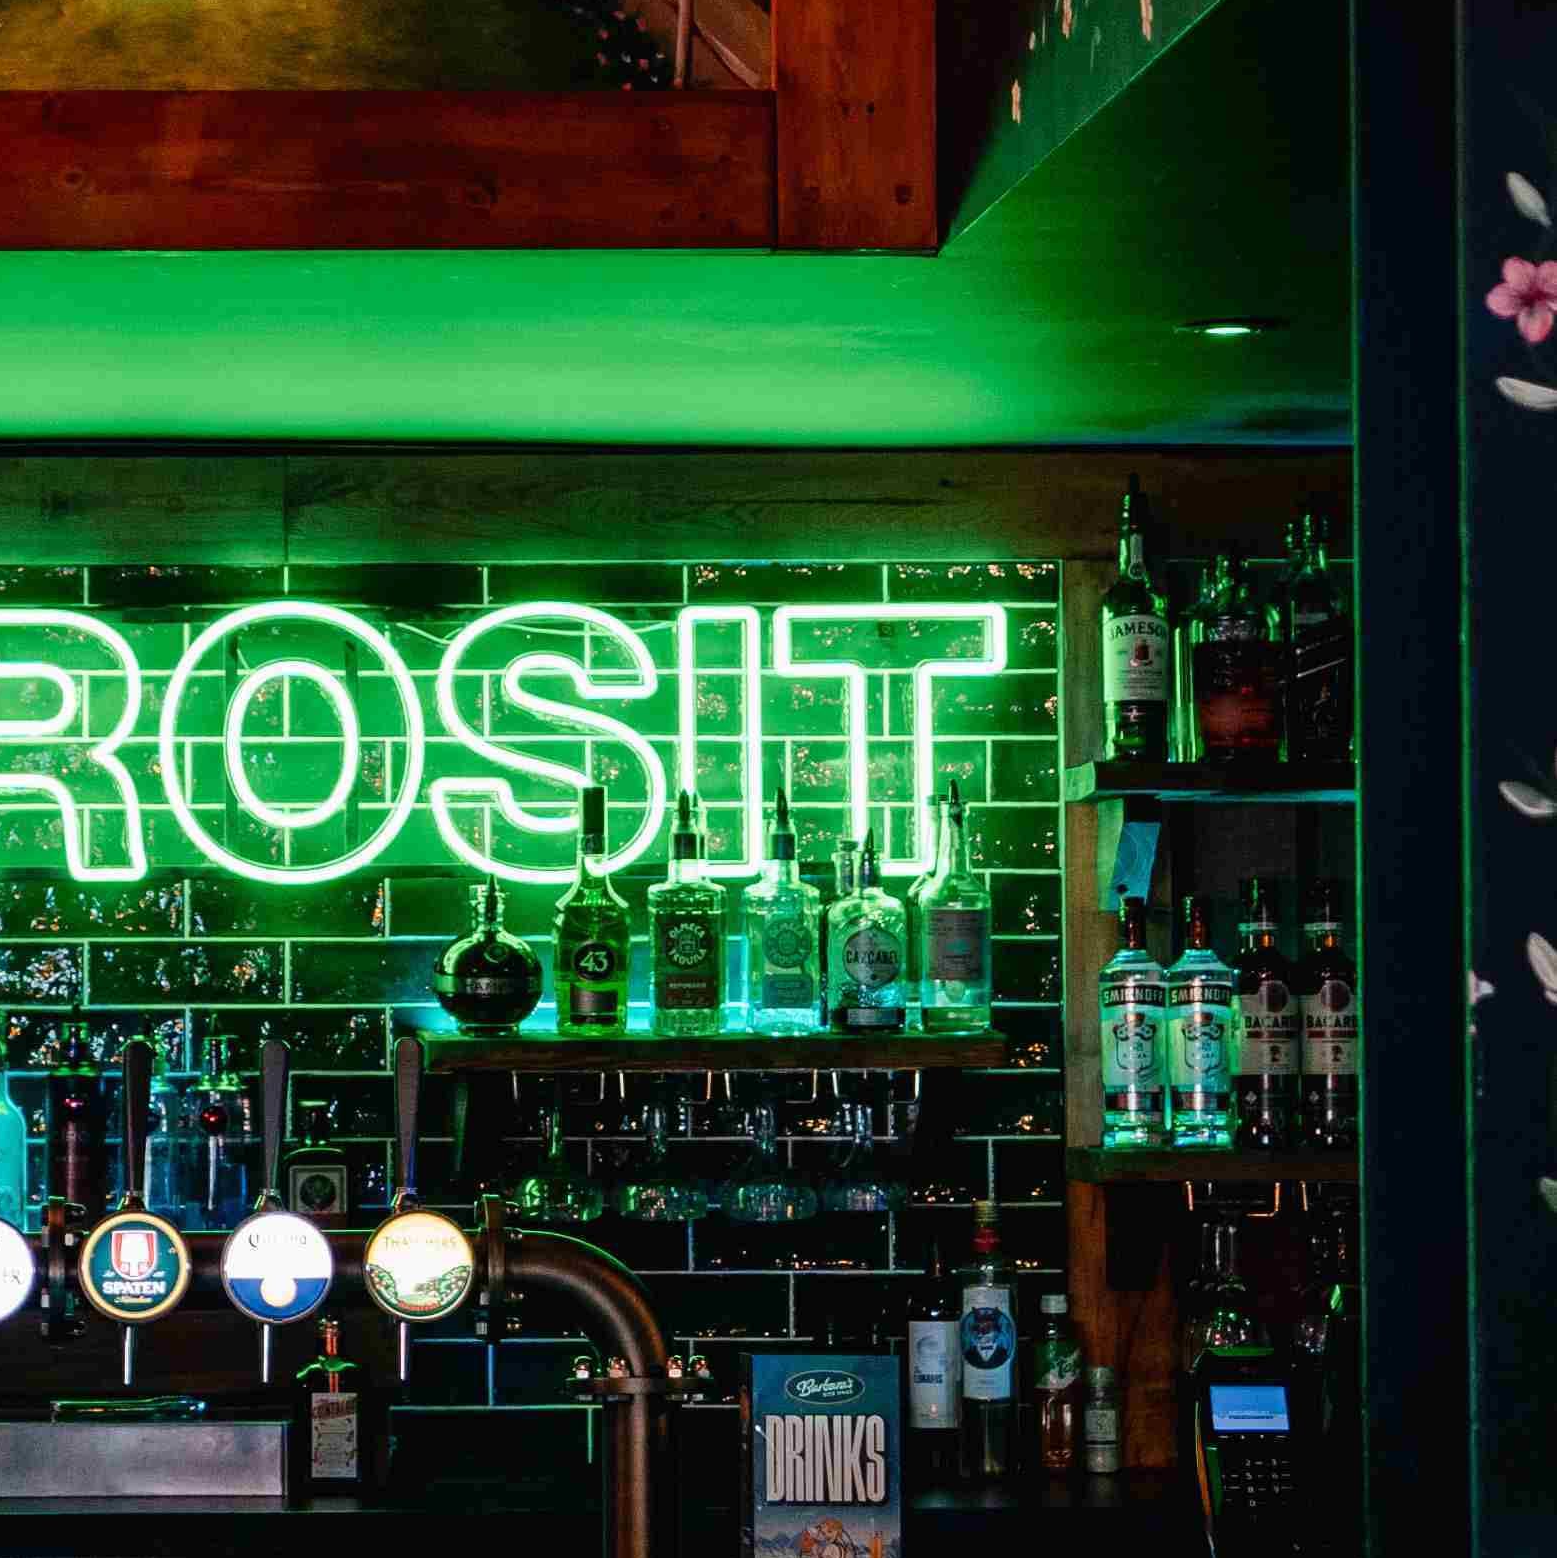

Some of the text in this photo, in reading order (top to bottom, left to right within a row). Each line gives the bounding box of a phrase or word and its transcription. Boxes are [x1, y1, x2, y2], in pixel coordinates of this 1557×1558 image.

[1110, 621, 1166, 639] JAMESO
[579, 950, 609, 972] 43
[102, 1280, 167, 1295] SPATEN
[765, 1414, 887, 1504] DRINKS
